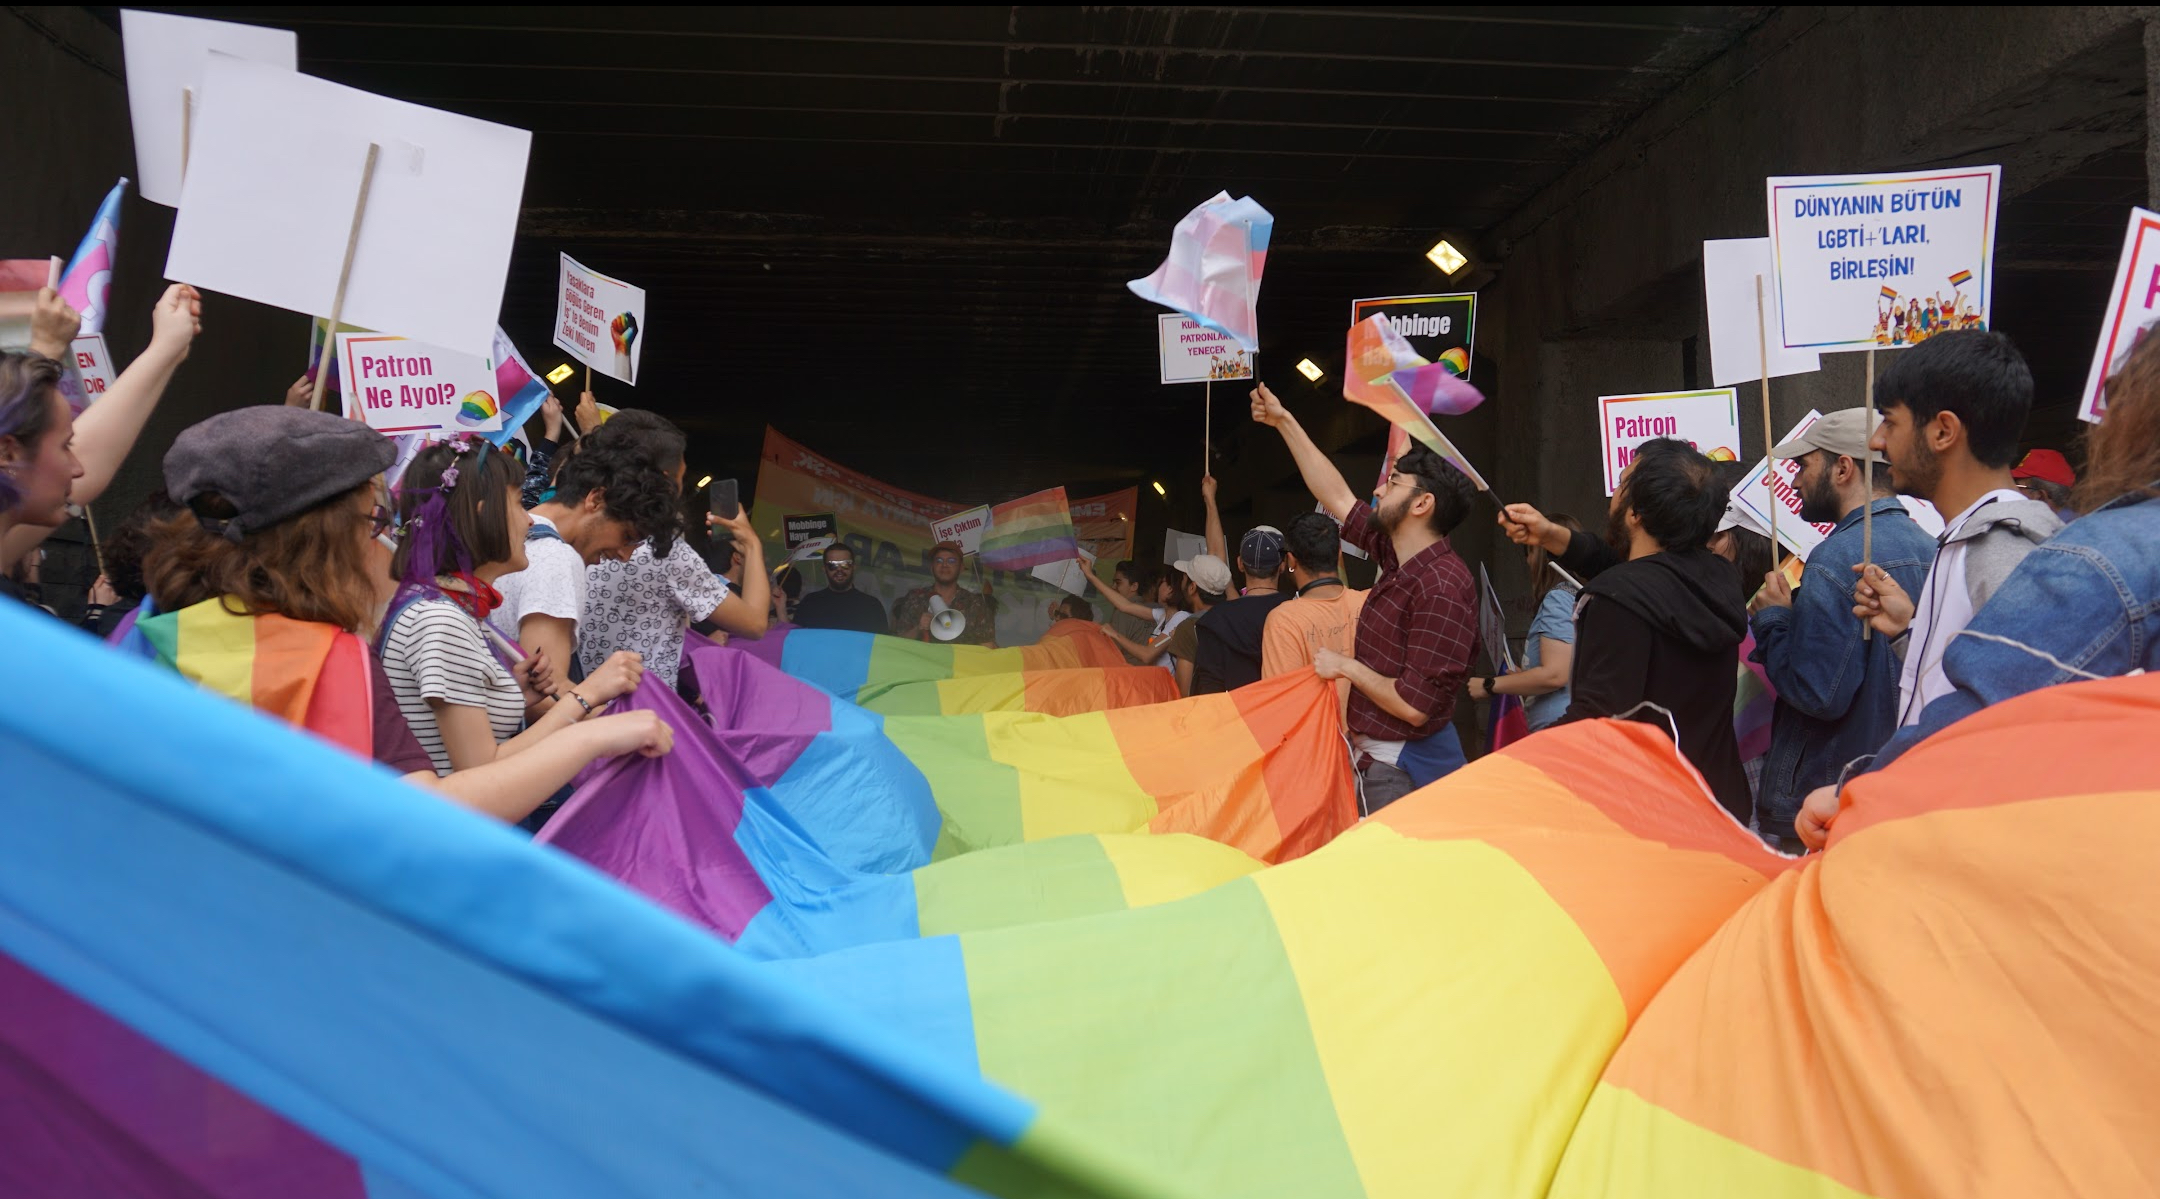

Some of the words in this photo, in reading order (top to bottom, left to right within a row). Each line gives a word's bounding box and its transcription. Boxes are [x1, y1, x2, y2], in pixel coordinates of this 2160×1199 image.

[1795, 194, 1884, 218] DÜNYANIN
[1891, 187, 1961, 213] BÜTÜN
[1830, 254, 1915, 280] BİRLEŞİN!
[567, 270, 594, 299] Yasaklara
[583, 299, 606, 324] Geren,
[562, 321, 574, 340] Zeki
[575, 330, 595, 354] Müren
[579, 314, 598, 337] Benim
[1187, 345, 1226, 356] YENECEK
[361, 355, 433, 379] Patron
[365, 386, 393, 409] Ne
[400, 383, 456, 409] Ayol?
[1615, 415, 1677, 438] Patron
[788, 520, 827, 531] Mobbinge
[954, 518, 982, 537] Çıktım
